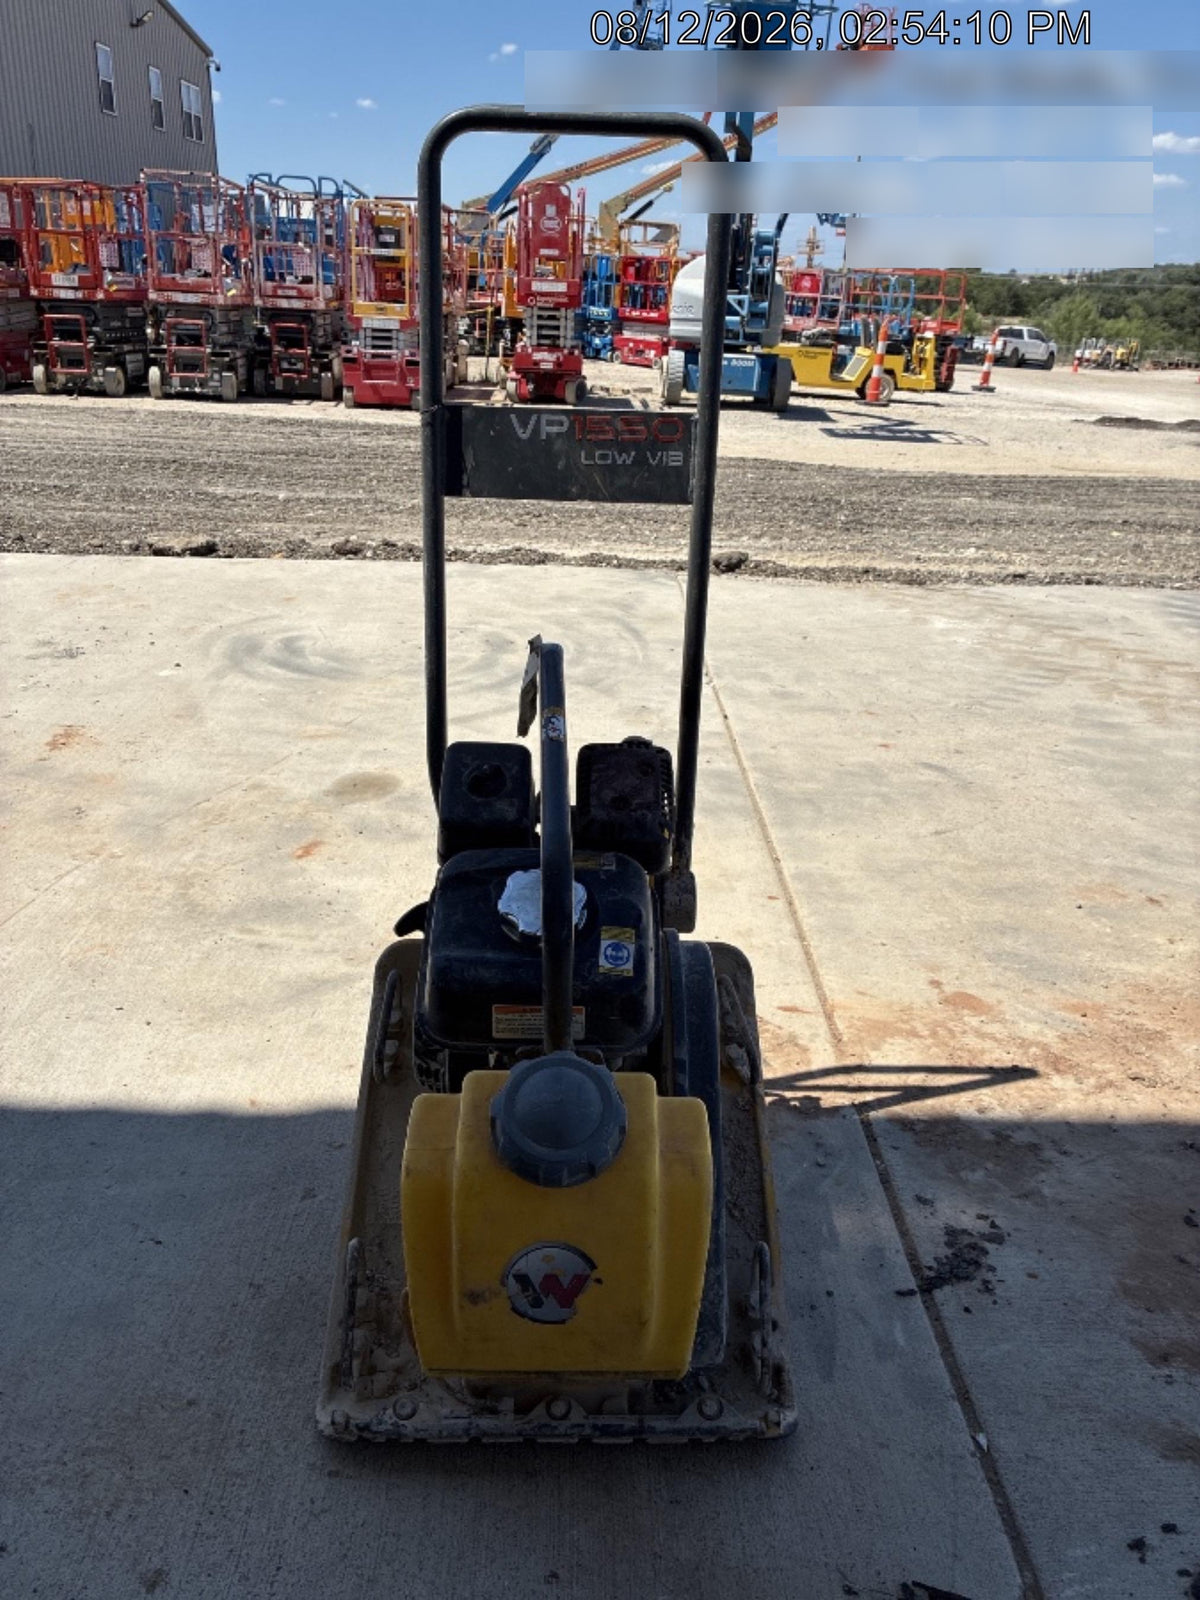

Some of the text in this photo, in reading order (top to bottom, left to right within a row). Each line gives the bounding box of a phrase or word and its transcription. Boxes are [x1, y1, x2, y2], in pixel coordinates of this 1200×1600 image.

[510, 413, 684, 443] VP1550
[580, 450, 684, 466] LOW VIB
